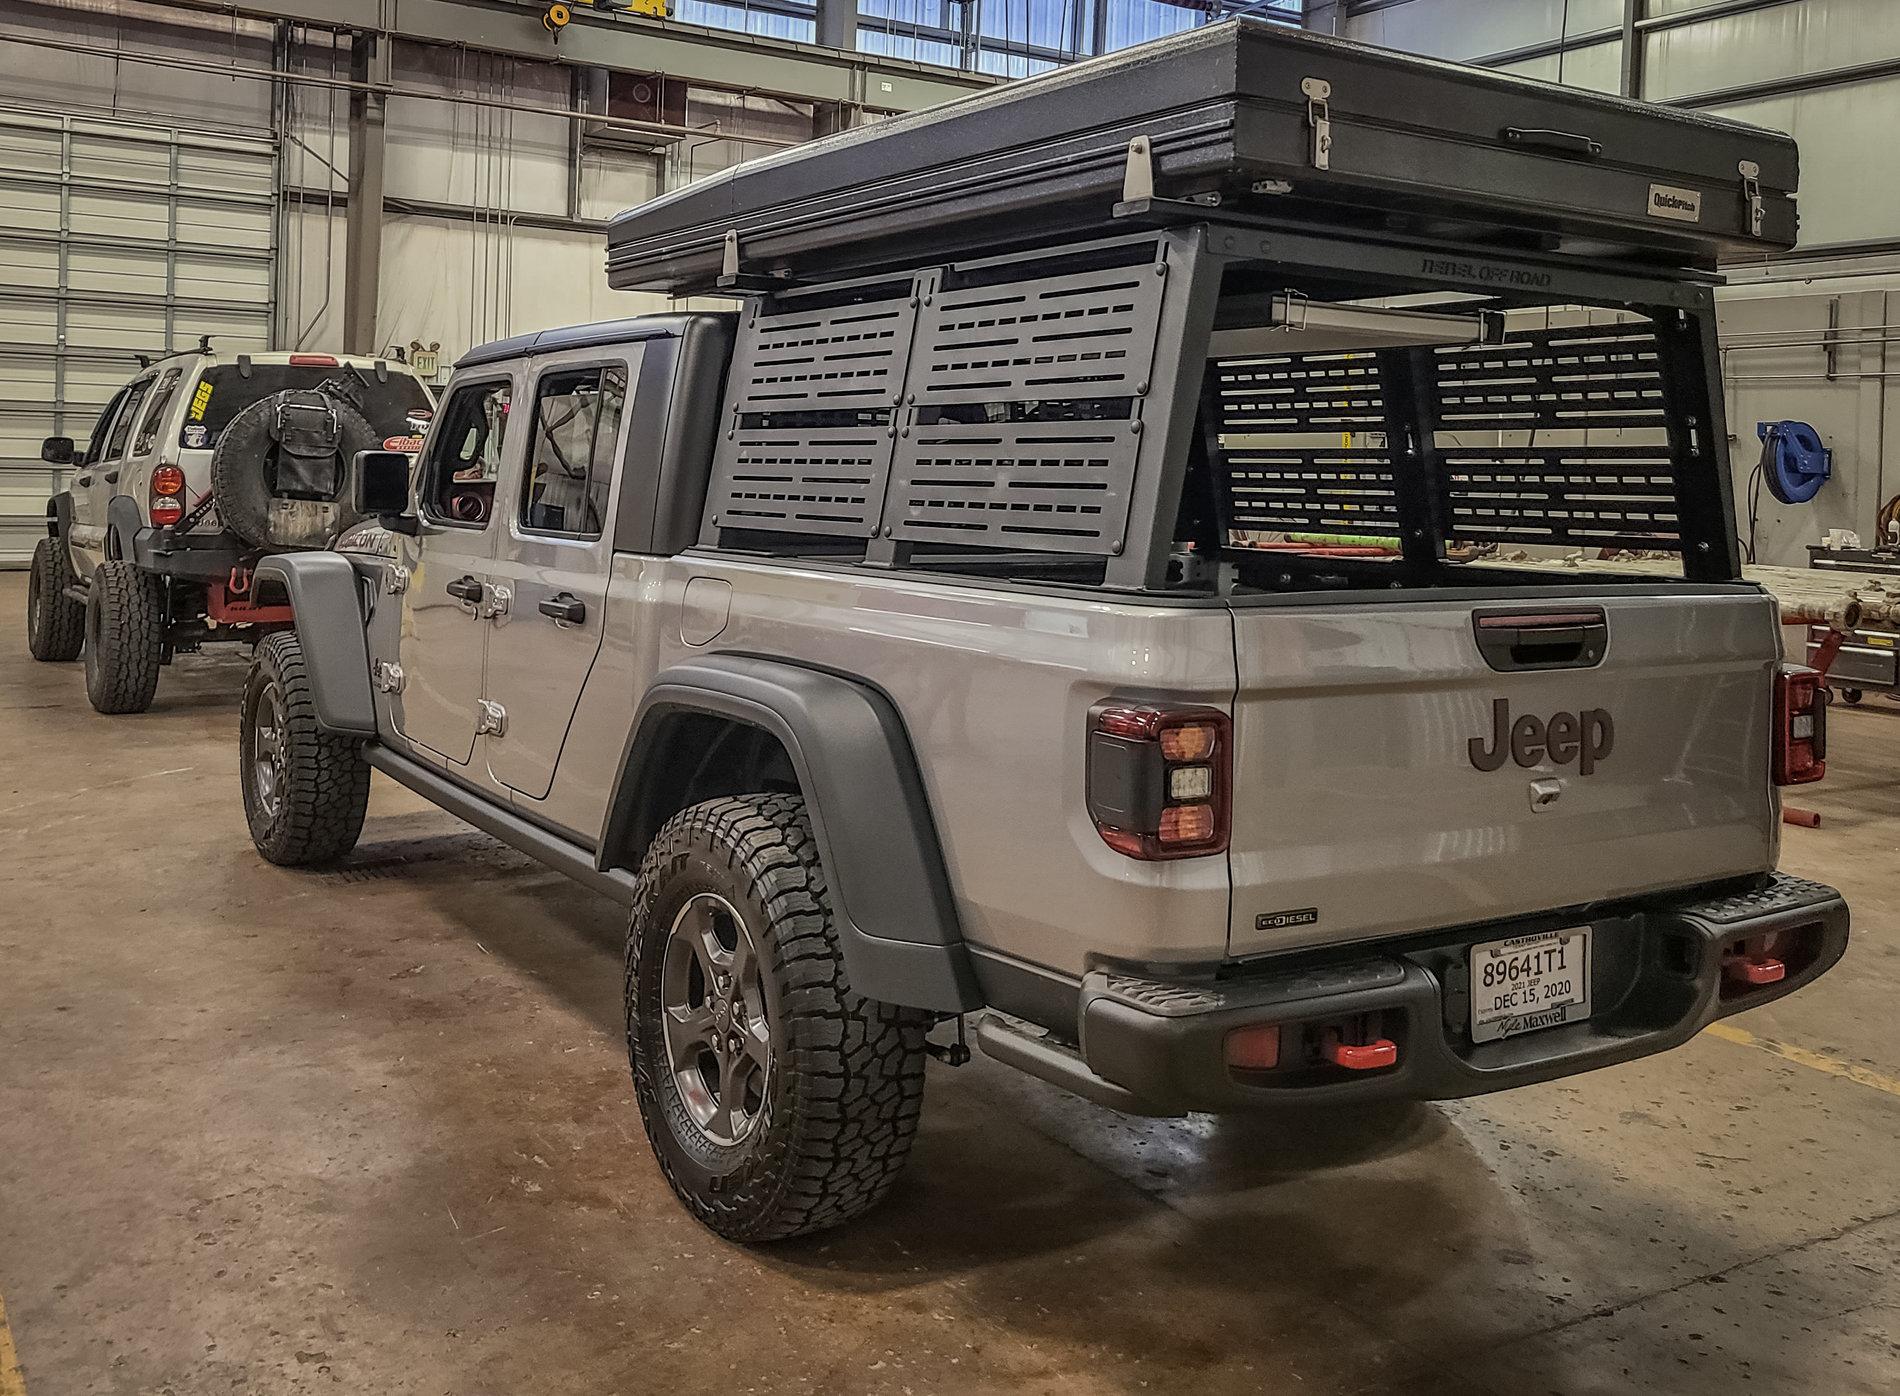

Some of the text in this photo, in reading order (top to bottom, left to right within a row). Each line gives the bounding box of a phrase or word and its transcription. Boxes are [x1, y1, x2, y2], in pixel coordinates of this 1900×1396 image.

[1421, 259, 1551, 287] REBEL OFF ROAD
[417, 356, 435, 370] EXIT
[190, 380, 214, 421] JEGS
[388, 436, 424, 448] Eibac
[1467, 698, 1615, 775] Jeep
[1262, 914, 1315, 925] ECODIESEL
[1503, 932, 1559, 947] CASTROVILLE
[1482, 946, 1567, 987] 89641T1
[1494, 992, 1518, 1011] DEC
[1522, 987, 1540, 1004] 15,
[1543, 979, 1571, 999] 2020
[1511, 977, 1541, 992] 2021 JEEP
[1522, 1006, 1566, 1030] Maxwell
